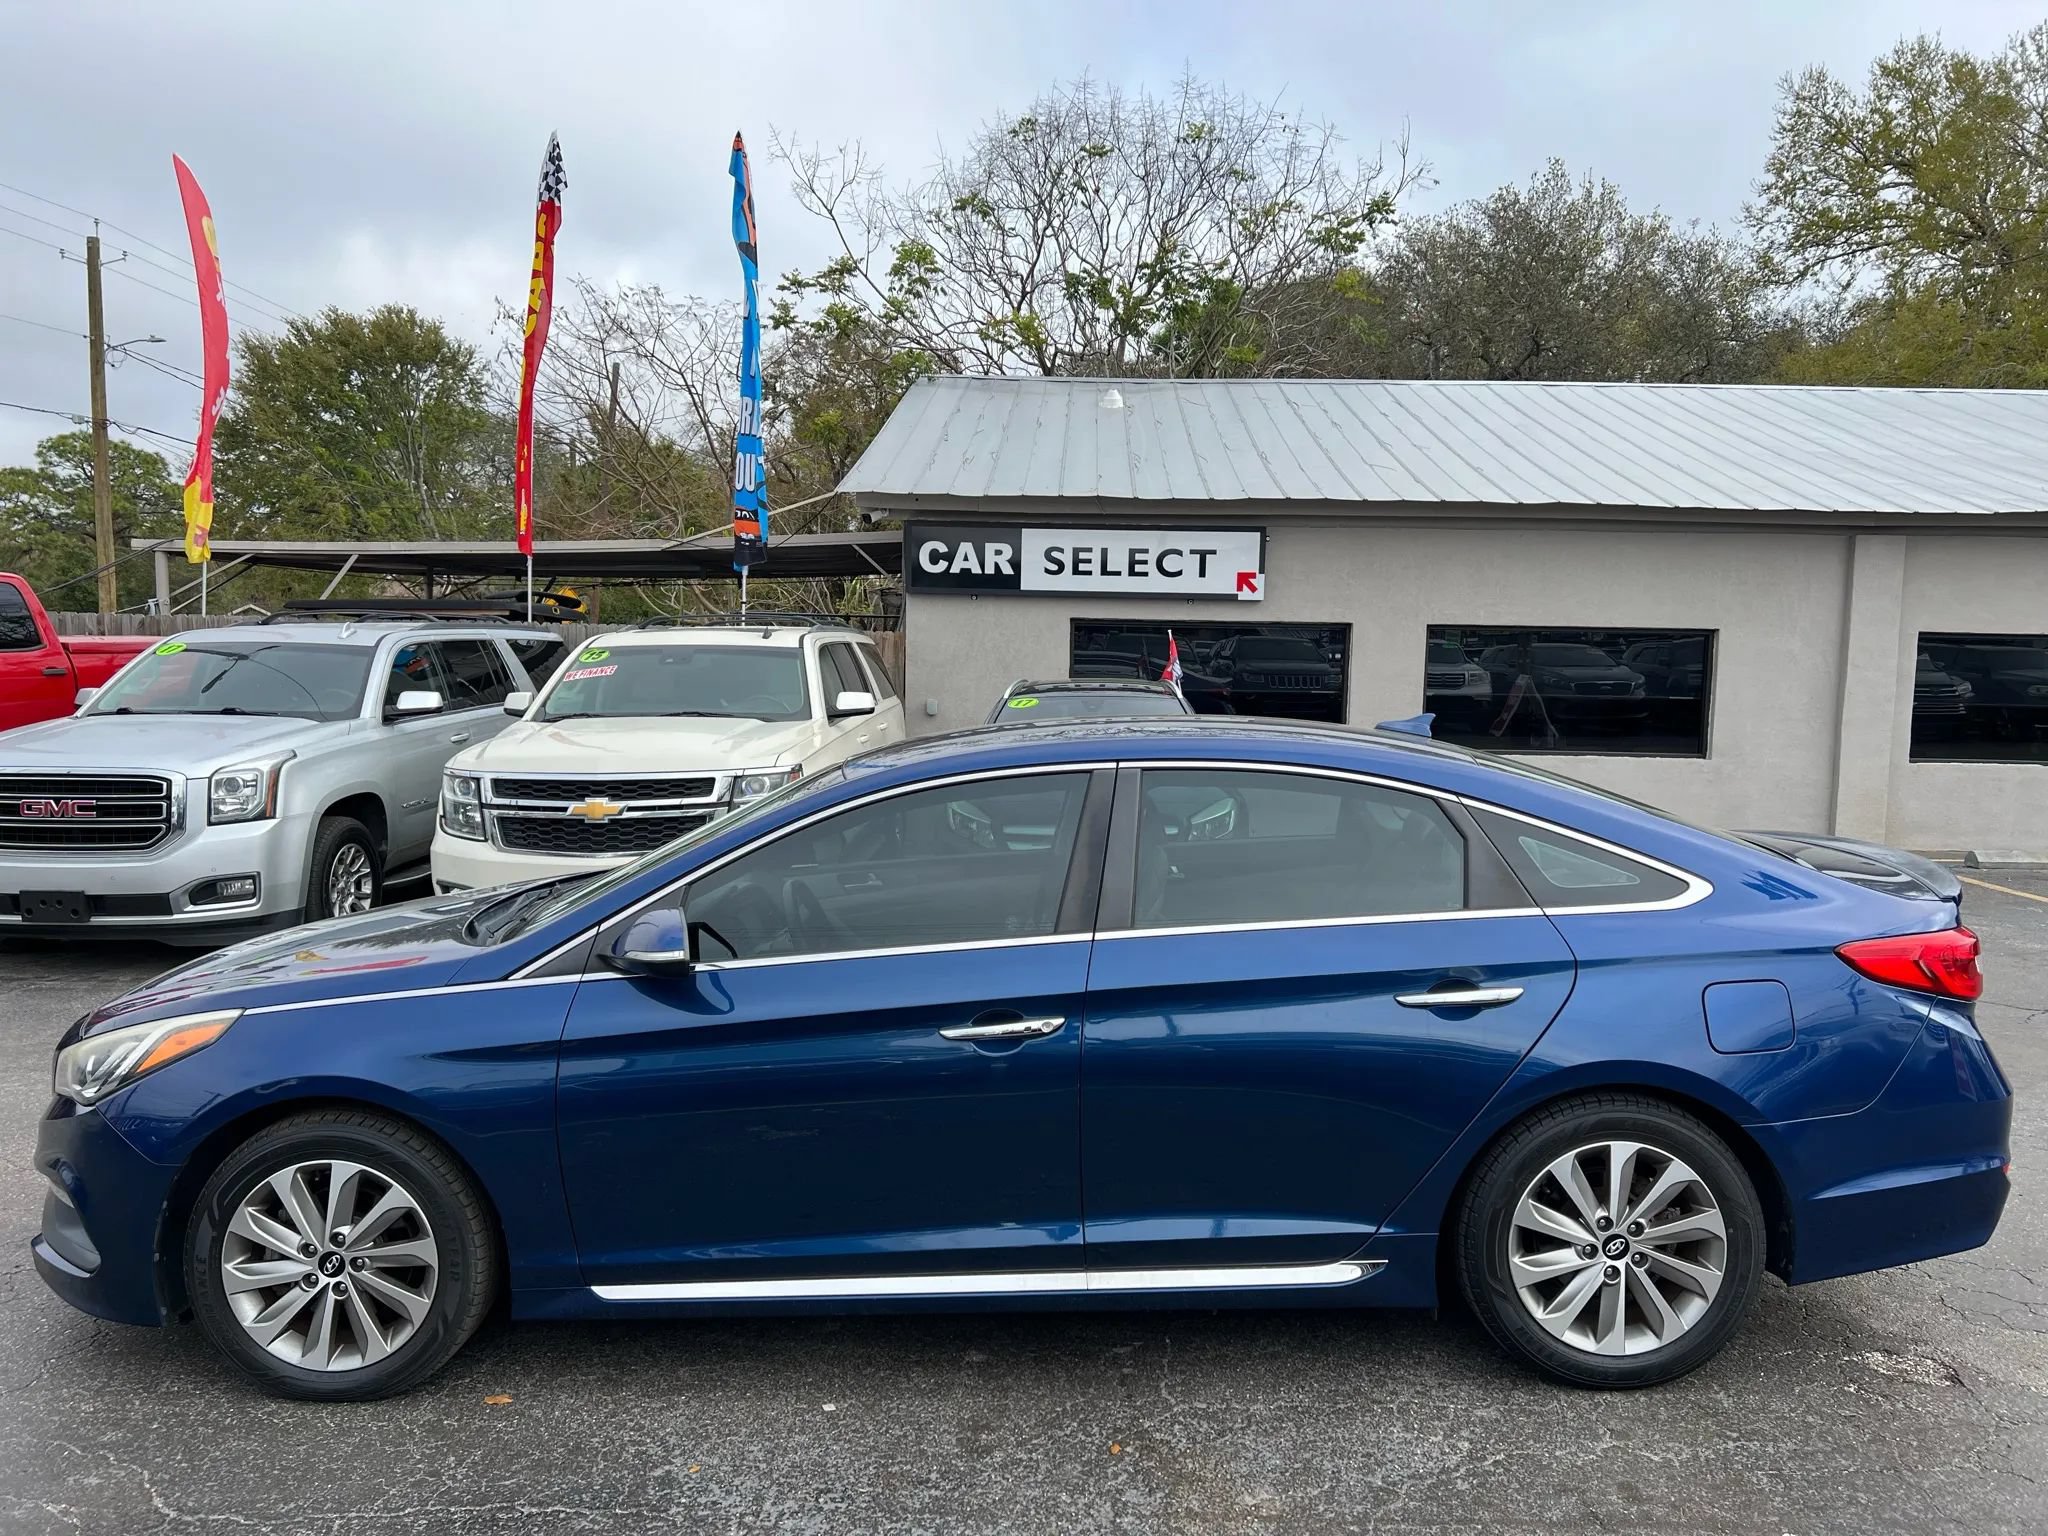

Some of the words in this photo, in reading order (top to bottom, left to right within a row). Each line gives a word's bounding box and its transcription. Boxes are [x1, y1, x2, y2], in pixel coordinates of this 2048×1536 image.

[918, 540, 1015, 575] CAR
[1043, 546, 1217, 578] SELECT
[564, 671, 578, 680] WE
[579, 665, 616, 678] FINANCE
[19, 799, 97, 818] GMC
